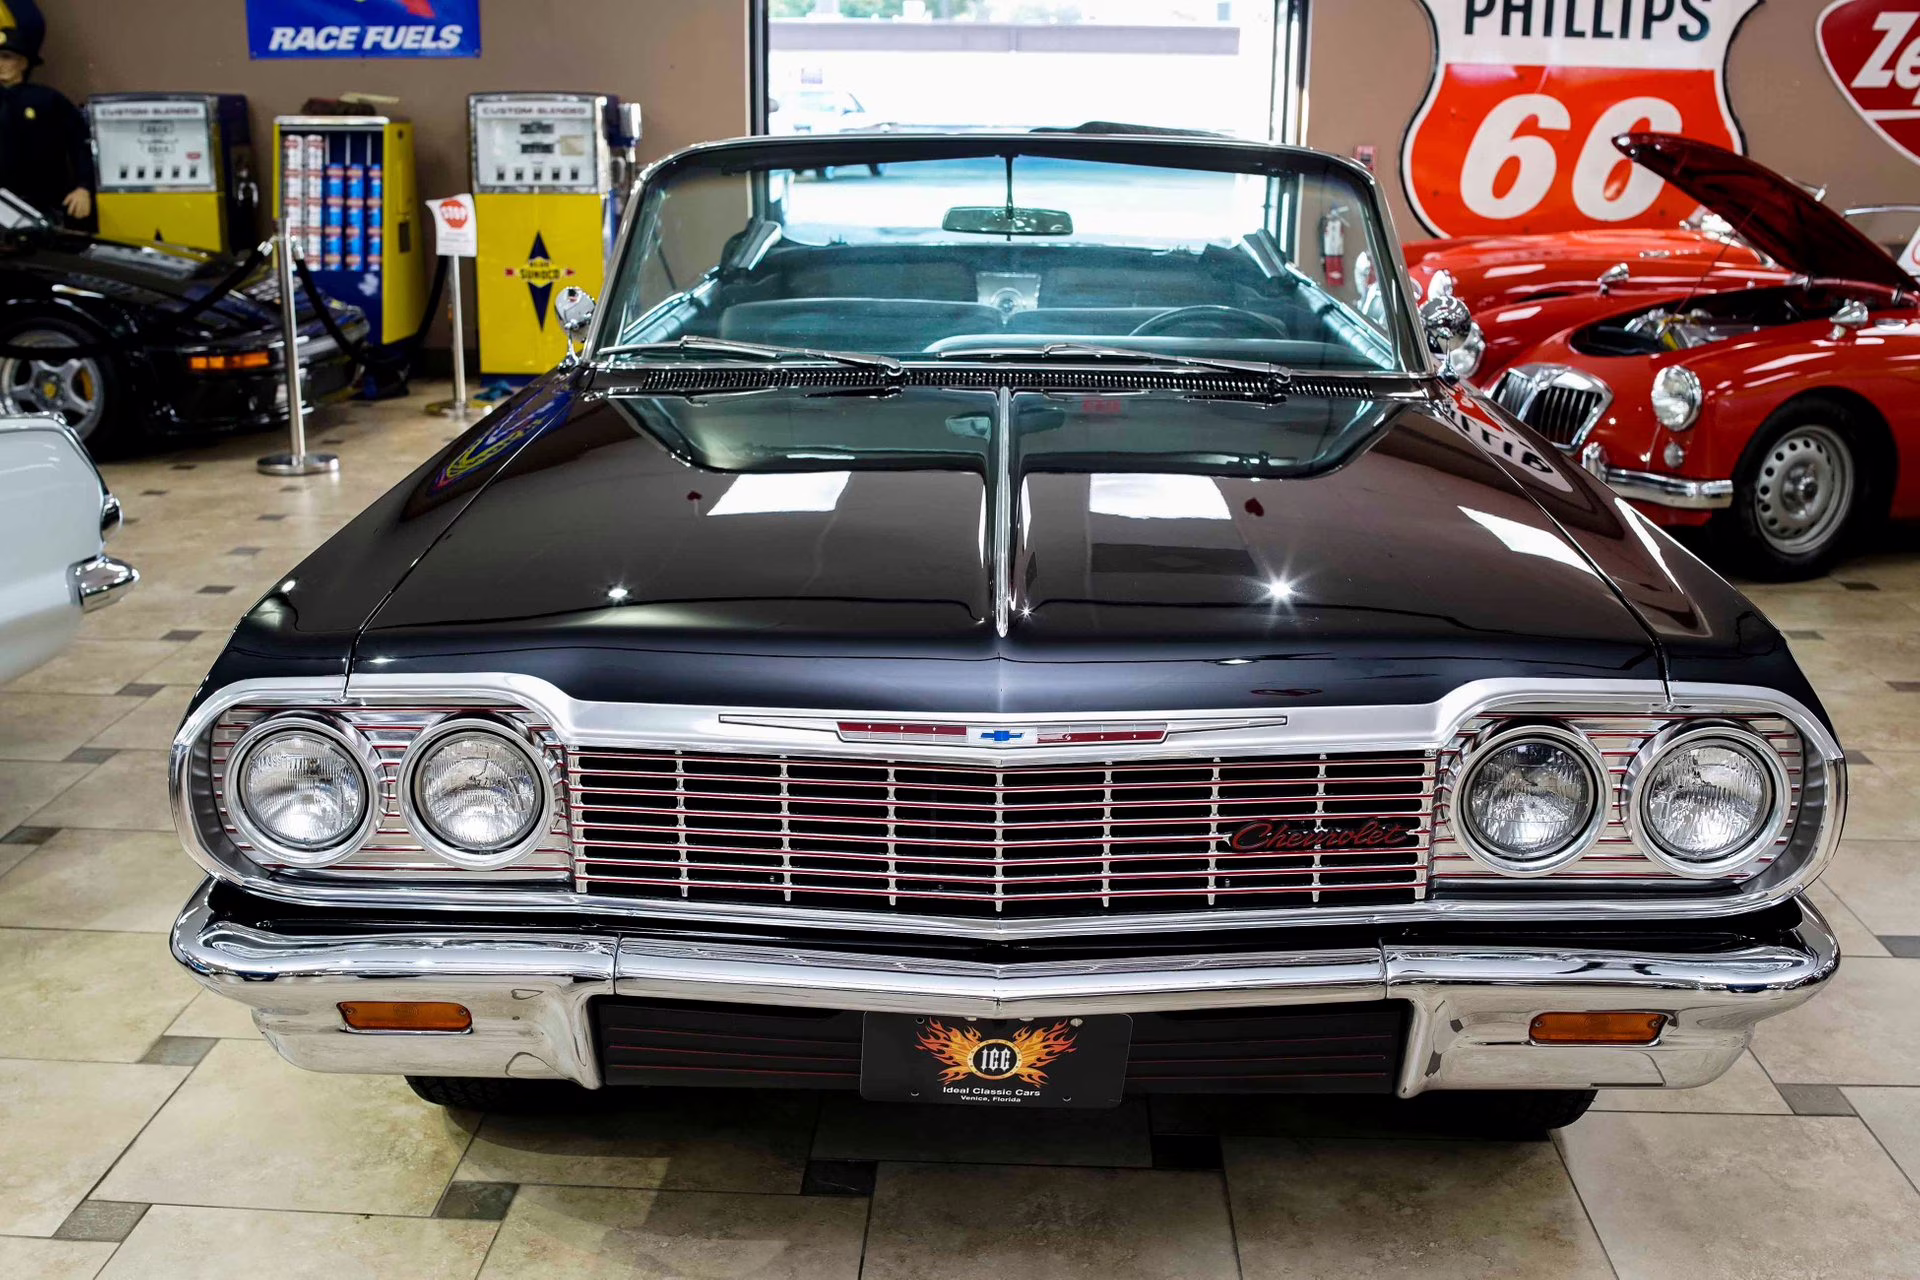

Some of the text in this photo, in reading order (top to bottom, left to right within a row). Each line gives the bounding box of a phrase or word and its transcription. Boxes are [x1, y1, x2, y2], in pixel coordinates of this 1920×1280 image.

[1464, 0, 1712, 41] PHILLIPS
[269, 24, 463, 51] RACE FUELS
[1850, 11, 1920, 107] Ze
[482, 106, 533, 115] CUSTOM
[1459, 93, 1684, 222] 66
[440, 205, 468, 221] STOP
[1232, 816, 1409, 851] Chevrolet
[943, 1086, 1041, 1097] Ideal Classic Cars
